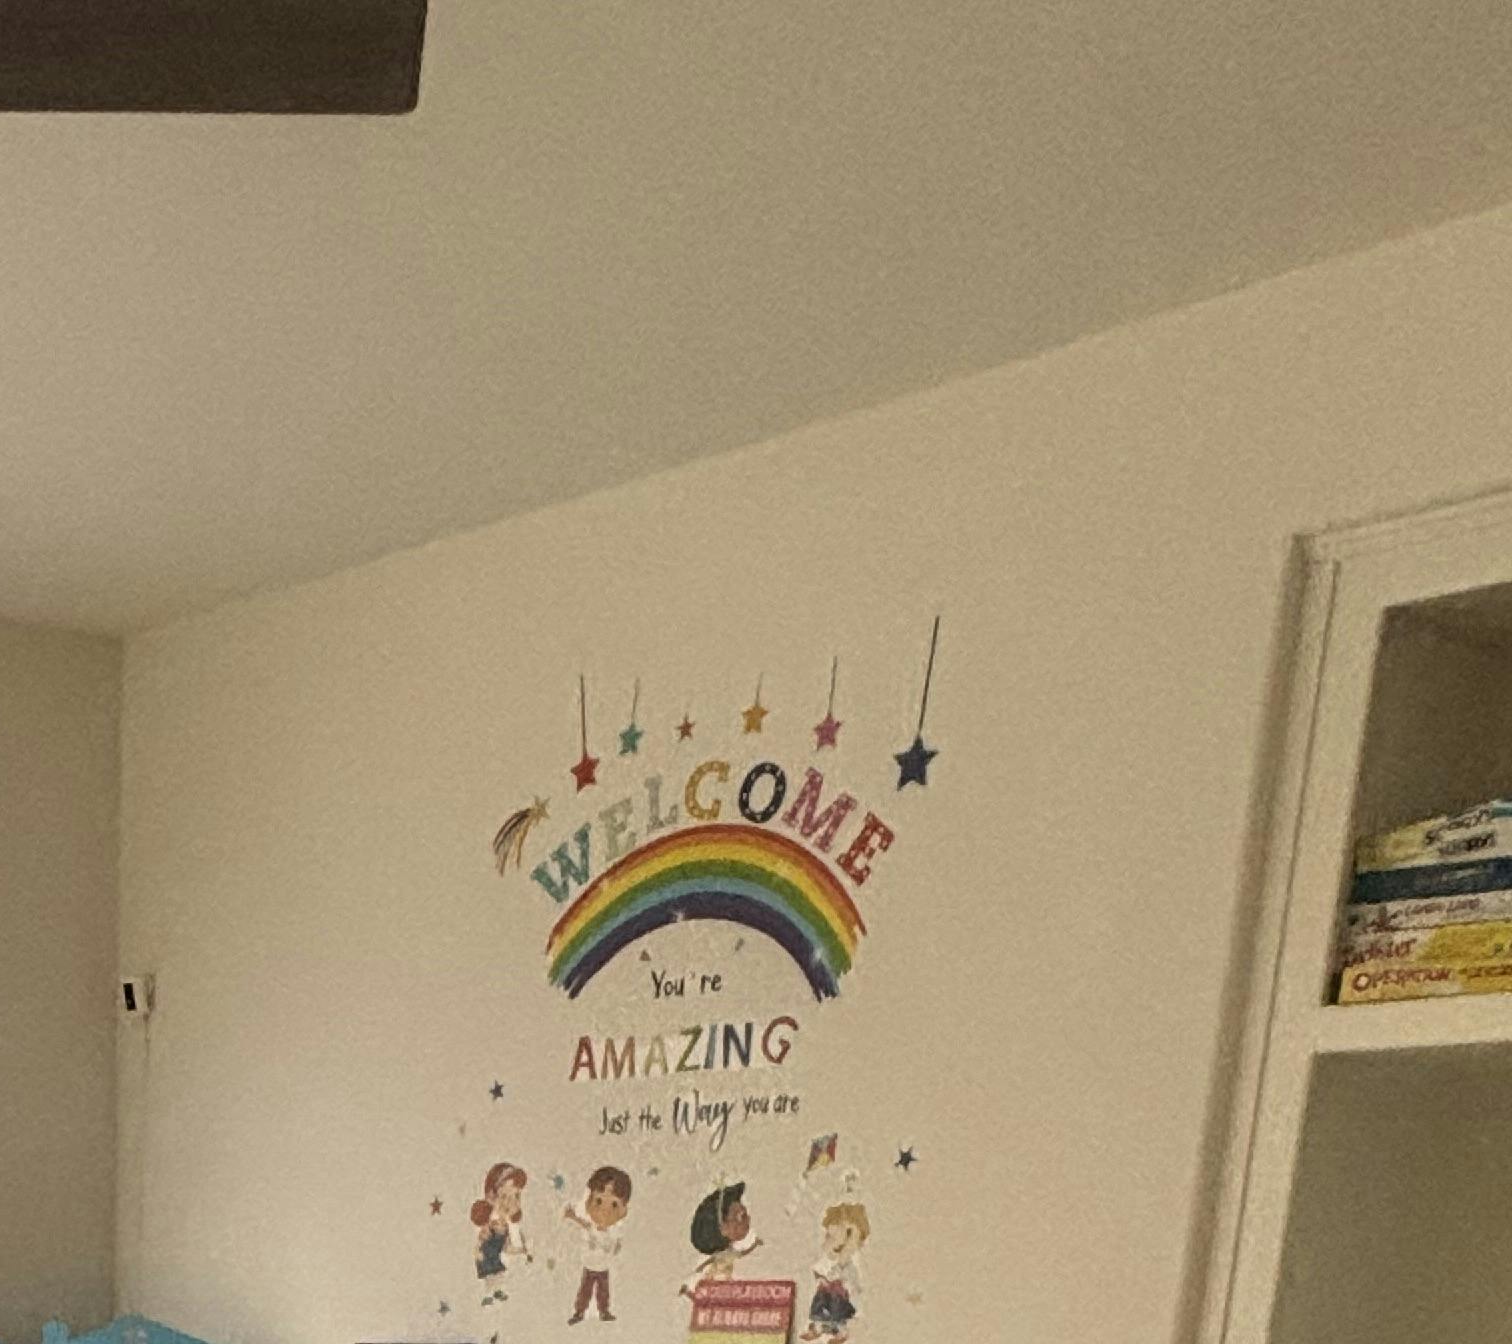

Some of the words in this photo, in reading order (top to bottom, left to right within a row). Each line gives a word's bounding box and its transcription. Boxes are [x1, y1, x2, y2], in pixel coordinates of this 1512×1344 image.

[530, 760, 895, 903] WELCOME
[651, 970, 722, 998] You're
[569, 1015, 799, 1082] AMAZING
[599, 1107, 630, 1135] Just
[639, 1107, 662, 1131] the
[672, 1089, 737, 1152] Way
[742, 1097, 770, 1122] you
[773, 1093, 800, 1114] are
